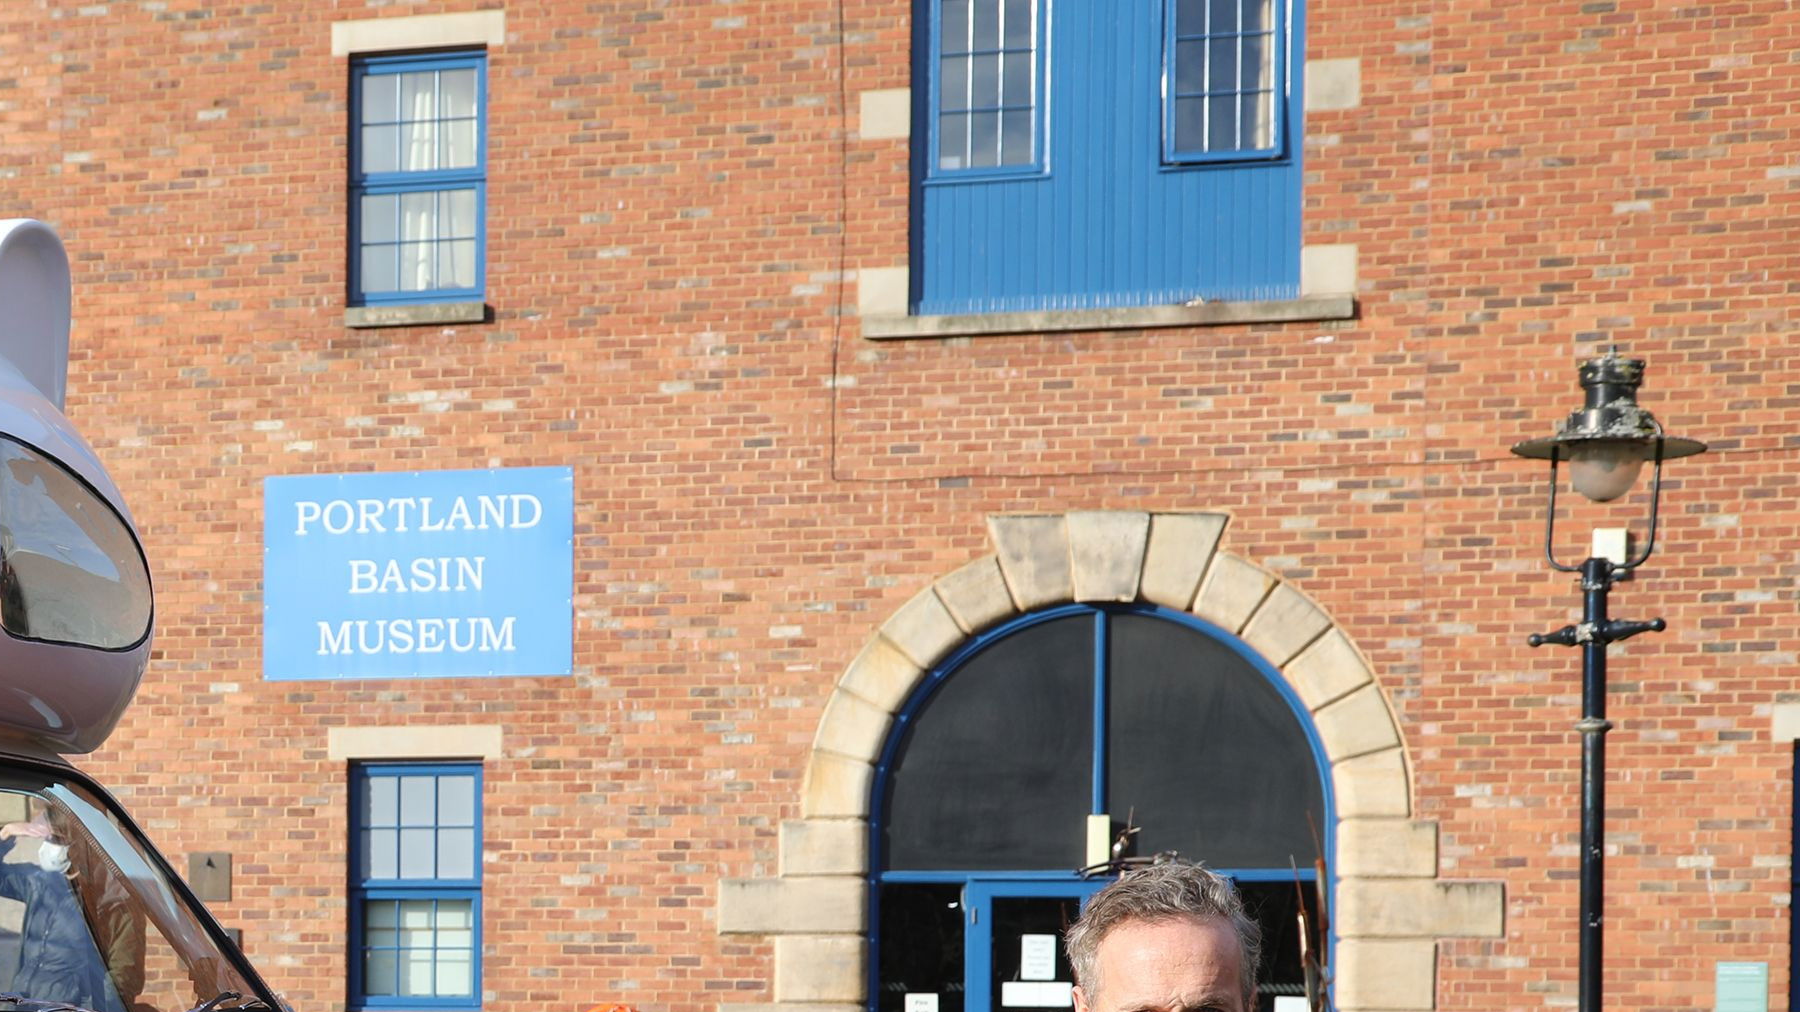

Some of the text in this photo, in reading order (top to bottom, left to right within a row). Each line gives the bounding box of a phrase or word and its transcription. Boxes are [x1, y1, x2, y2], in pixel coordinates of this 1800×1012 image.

[294, 494, 543, 535] PORTLAND
[348, 556, 486, 594] BASIN
[316, 616, 517, 657] MUSEUM
